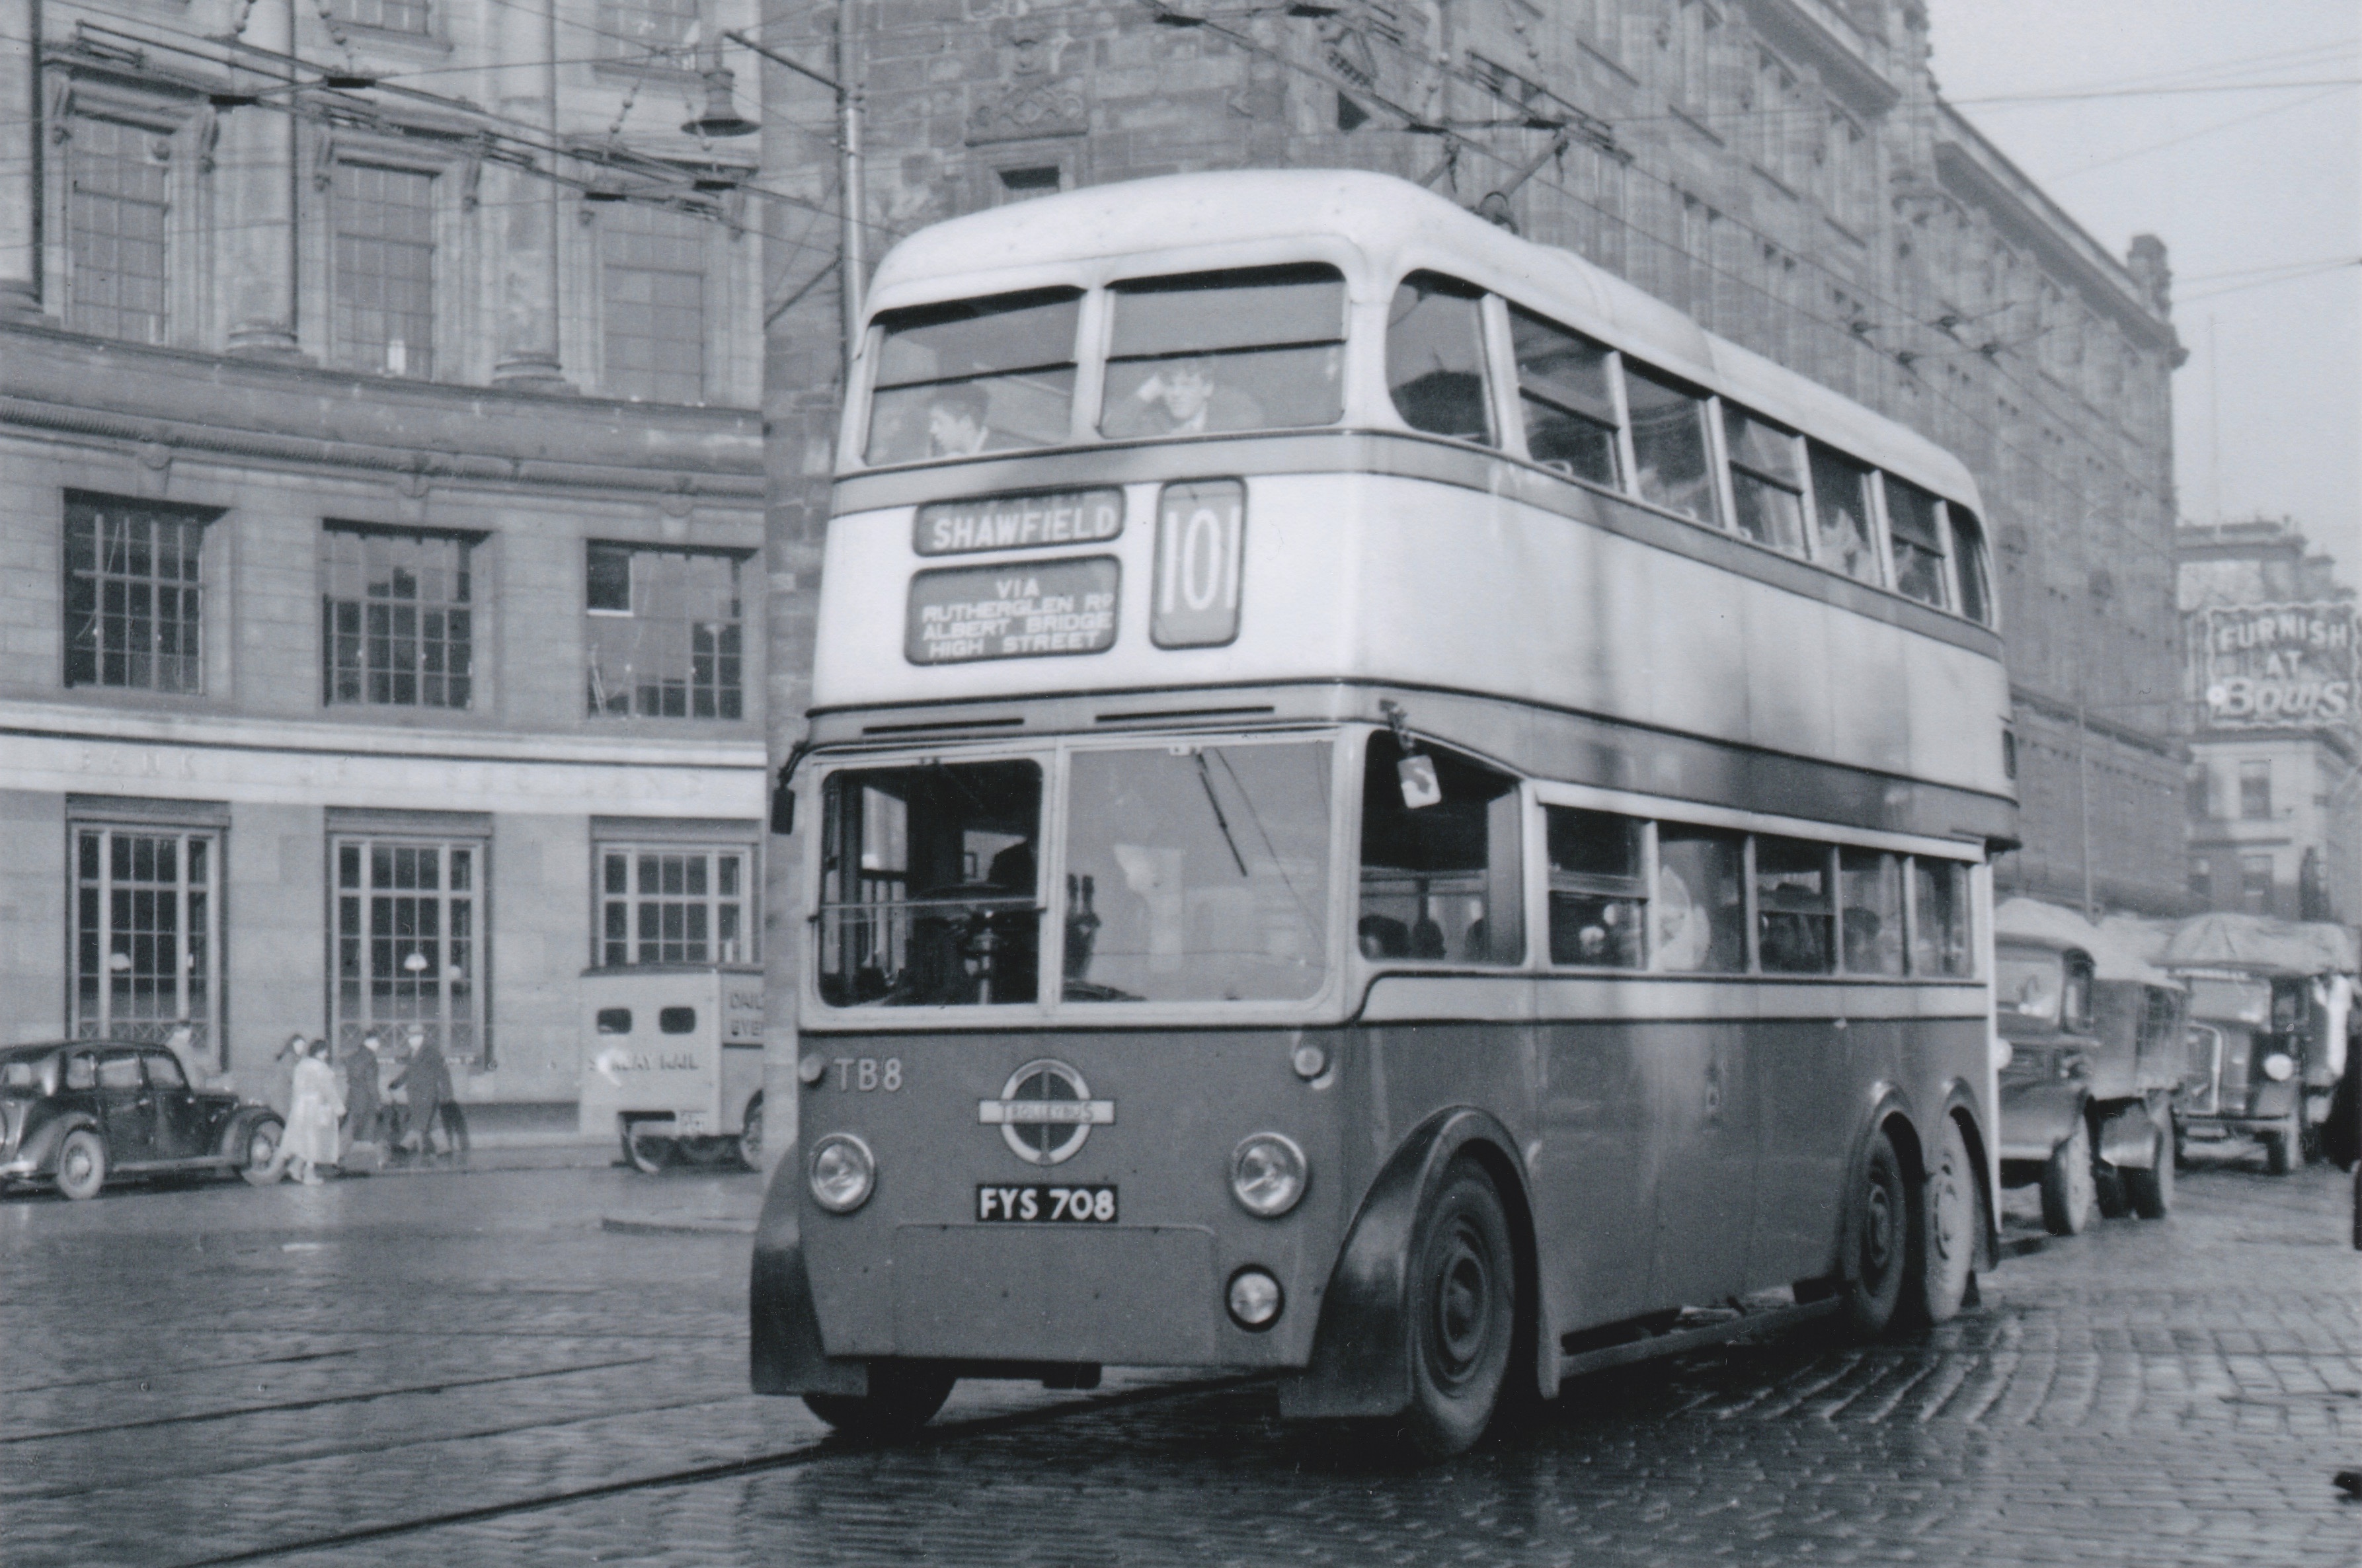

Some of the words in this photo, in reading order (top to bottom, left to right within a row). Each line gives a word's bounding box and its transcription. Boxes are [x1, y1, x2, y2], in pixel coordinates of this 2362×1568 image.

[933, 506, 1117, 551] SHAWFIELD
[1161, 505, 1241, 615] 101
[996, 578, 1041, 599] VIA
[922, 596, 1074, 623] RUTHERGLEN
[923, 618, 1011, 641] ALBERT
[1027, 611, 1113, 635] BRIDGE
[2219, 613, 2349, 652] FURNISH
[928, 638, 985, 659] HIGH
[1003, 630, 1100, 652] STREET
[2266, 650, 2304, 675] AT
[834, 1058, 902, 1092] TB8
[980, 1189, 1039, 1220] FYS
[1049, 1189, 1115, 1221] 708
